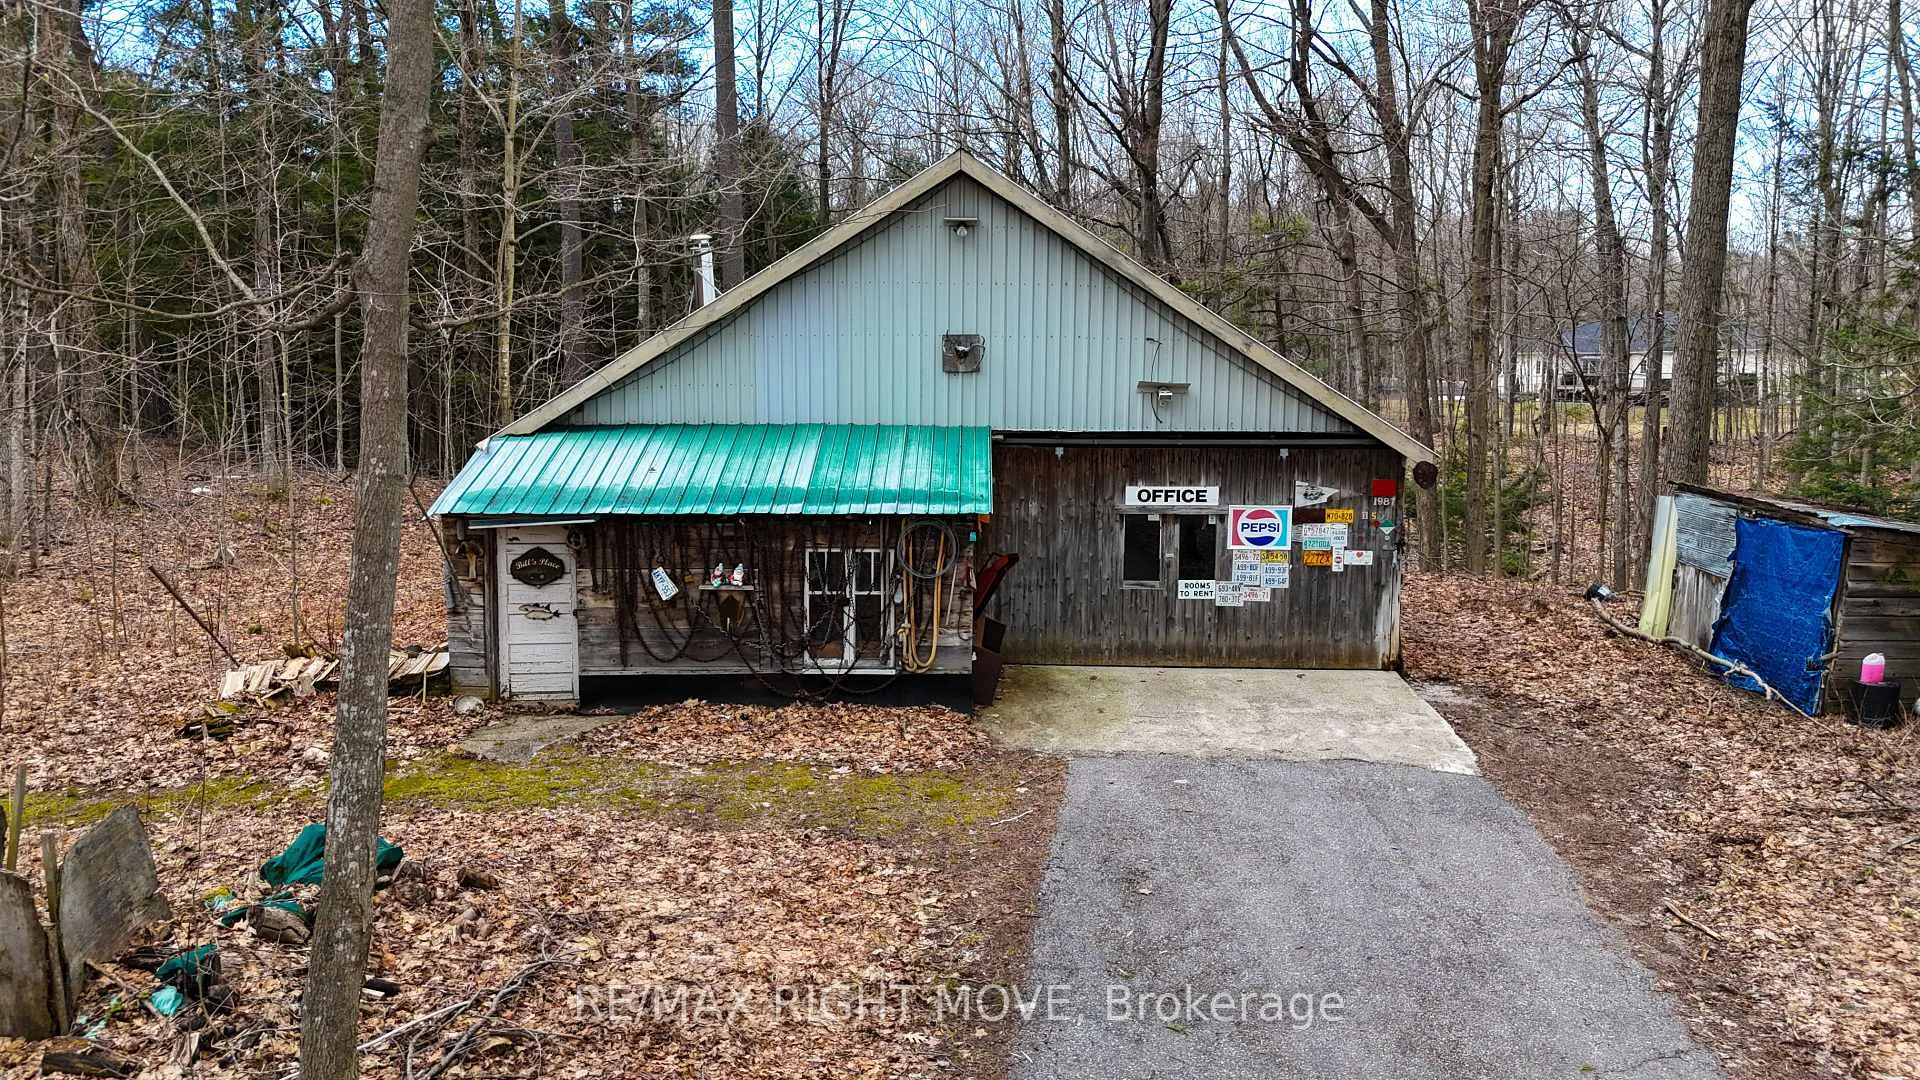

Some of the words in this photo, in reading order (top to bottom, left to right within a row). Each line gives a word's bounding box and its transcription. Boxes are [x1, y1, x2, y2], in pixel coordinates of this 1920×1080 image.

[1137, 489, 1208, 503] OFFICE
[1373, 497, 1396, 506] 1987
[1240, 522, 1280, 533] PEPSI
